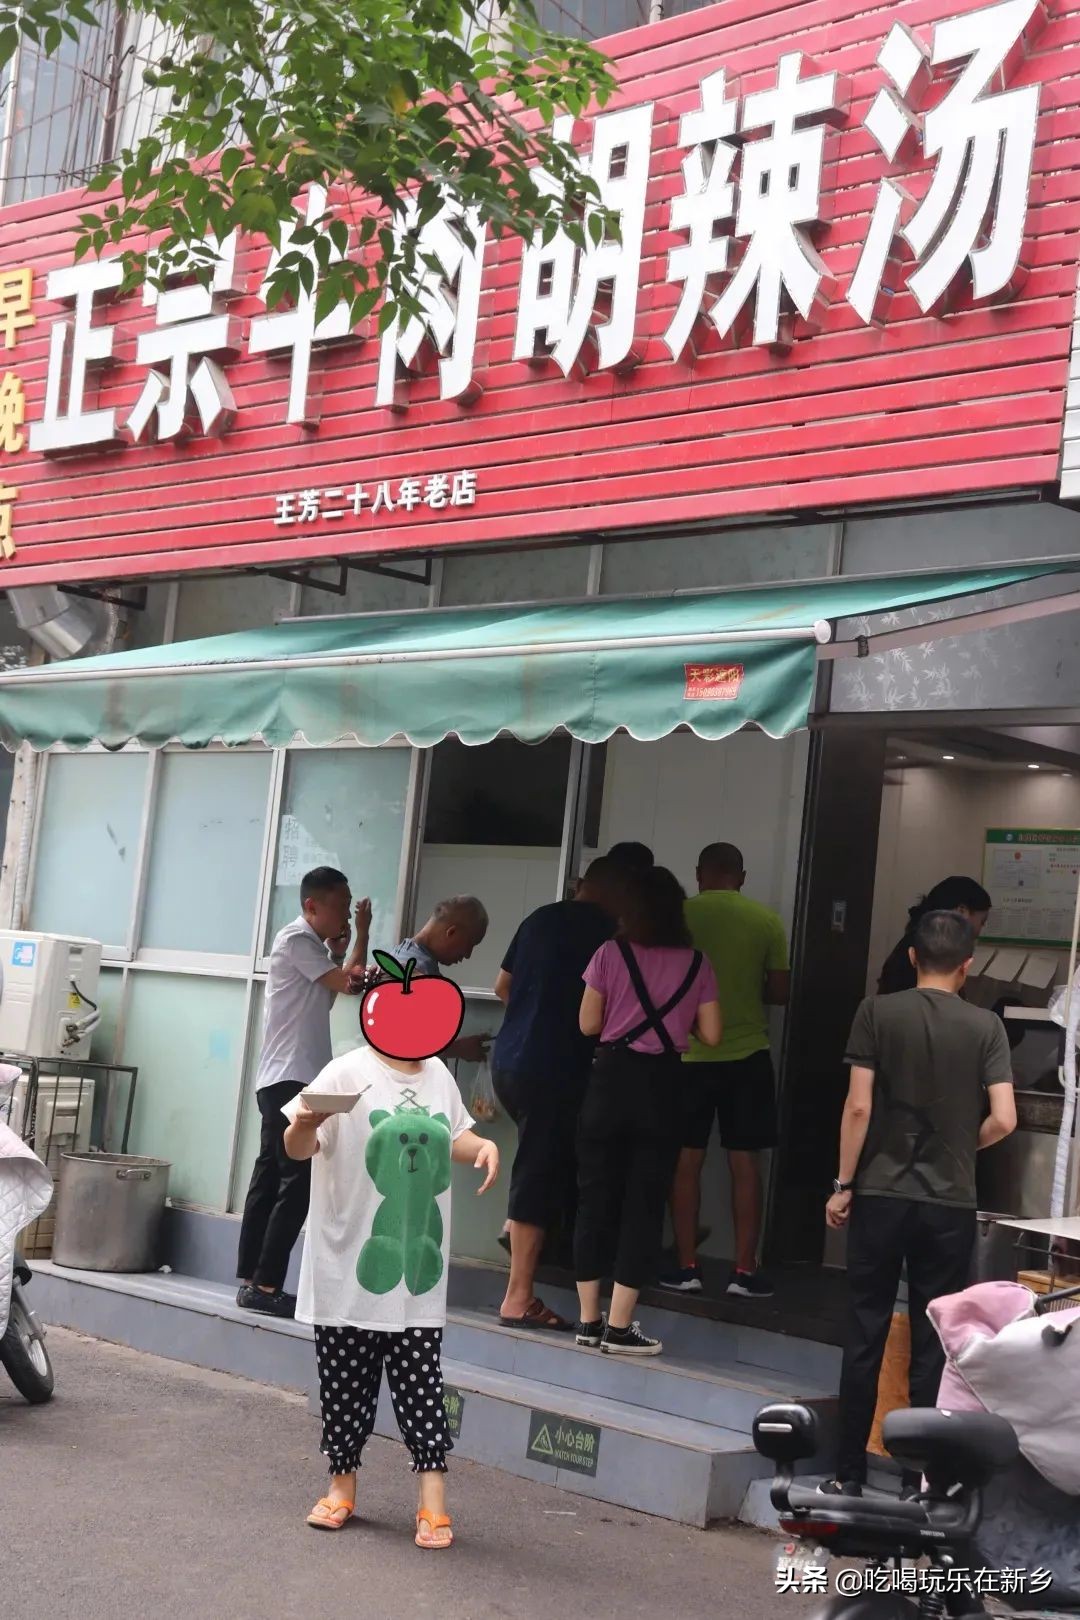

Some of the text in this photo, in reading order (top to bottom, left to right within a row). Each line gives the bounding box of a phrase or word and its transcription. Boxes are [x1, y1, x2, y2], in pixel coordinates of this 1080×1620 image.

[273, 470, 478, 525] 王芳二十八年老店
[554, 1425, 595, 1453] 小心台阶
[554, 1448, 594, 1468] WATCH YOUR STEP
